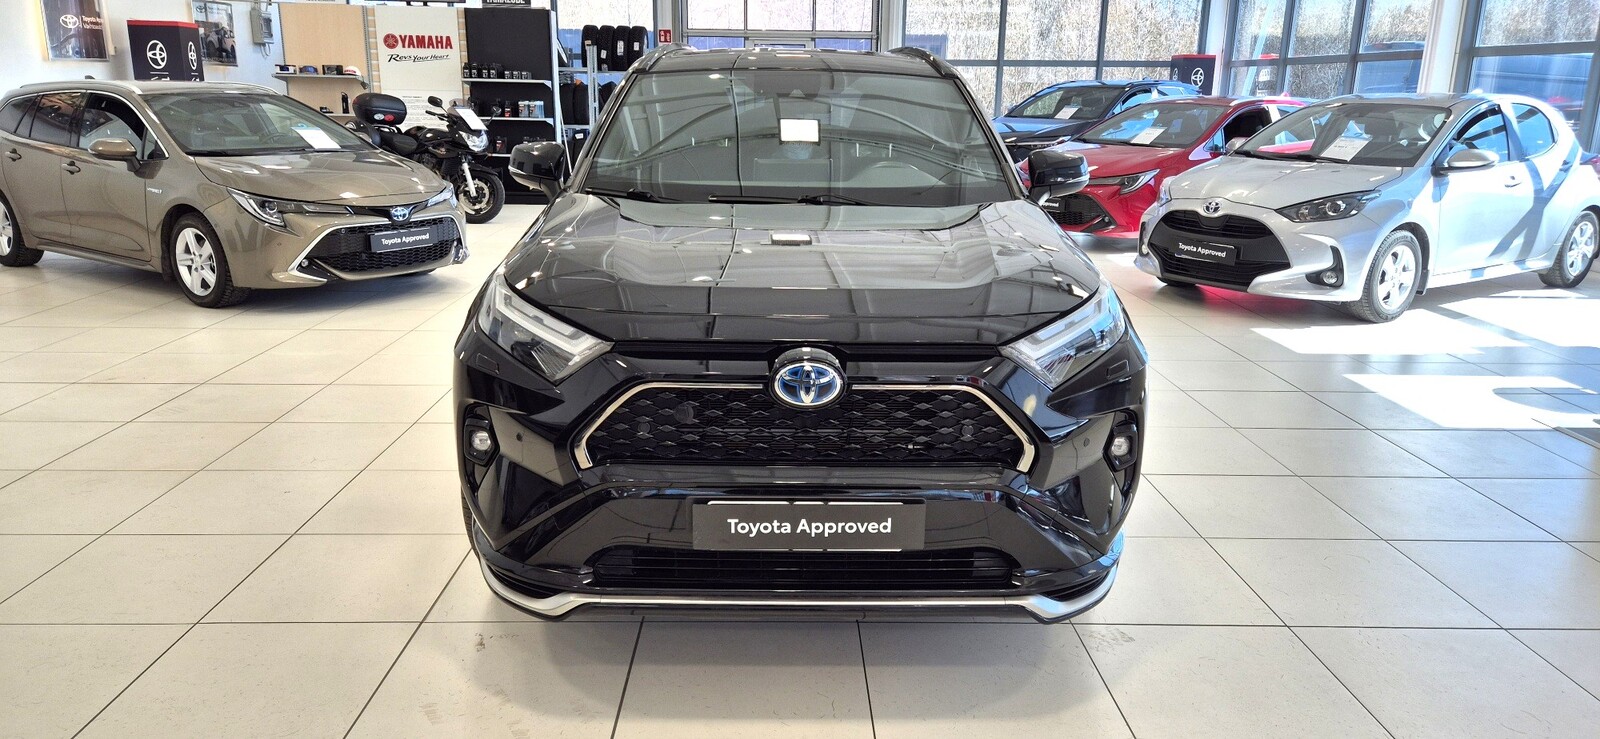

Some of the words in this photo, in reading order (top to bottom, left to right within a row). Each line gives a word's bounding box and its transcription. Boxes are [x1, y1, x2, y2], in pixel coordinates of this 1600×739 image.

[398, 34, 454, 50] YAMAHA
[386, 53, 413, 63] Revs
[411, 54, 430, 63] Your
[381, 237, 401, 246] Toyota
[402, 233, 430, 243] Approved
[1178, 242, 1197, 252] Toyota
[1196, 246, 1227, 258] Approved
[727, 518, 792, 537] Toyota
[796, 517, 892, 537] Approved
